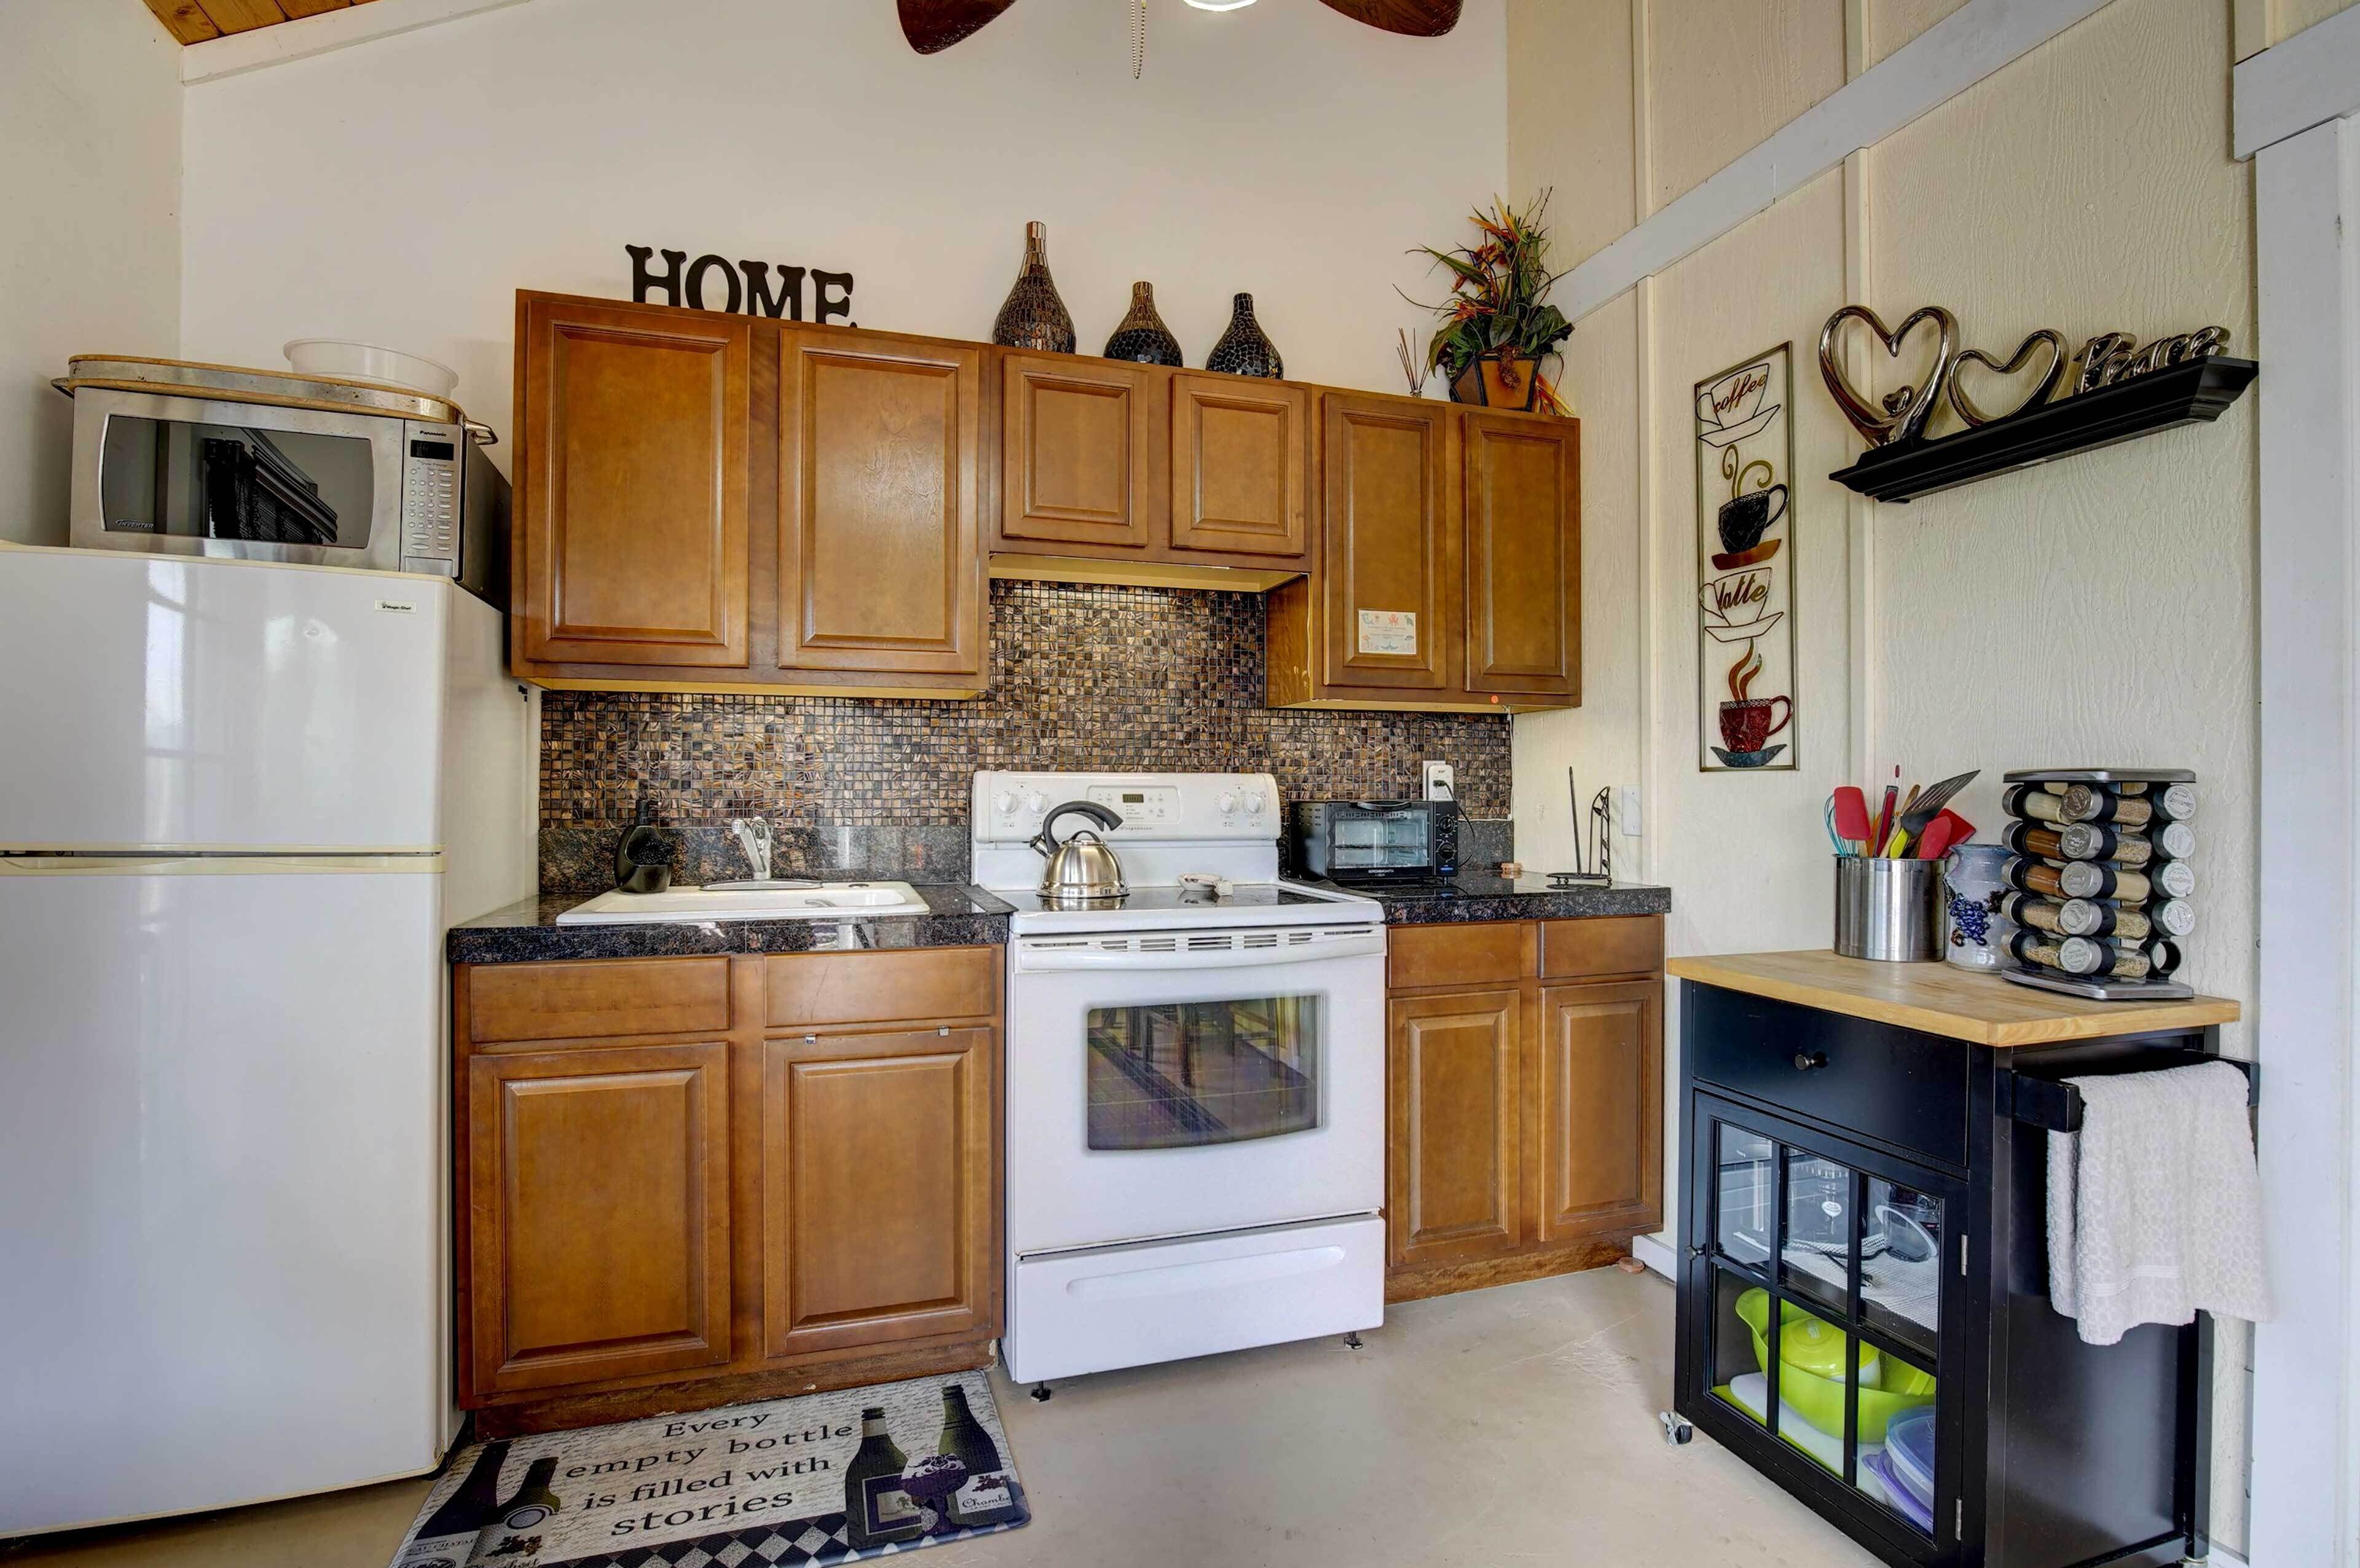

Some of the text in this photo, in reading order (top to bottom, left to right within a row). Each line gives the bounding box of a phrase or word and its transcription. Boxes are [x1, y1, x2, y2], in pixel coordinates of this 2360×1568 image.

[626, 244, 858, 328] HOME
[1713, 374, 1767, 414] coffee
[1718, 573, 1768, 610] latte
[662, 1414, 770, 1438] Every
[565, 1425, 853, 1478] empty bottle
[581, 1457, 831, 1510] is filled with
[611, 1490, 793, 1536] stories
